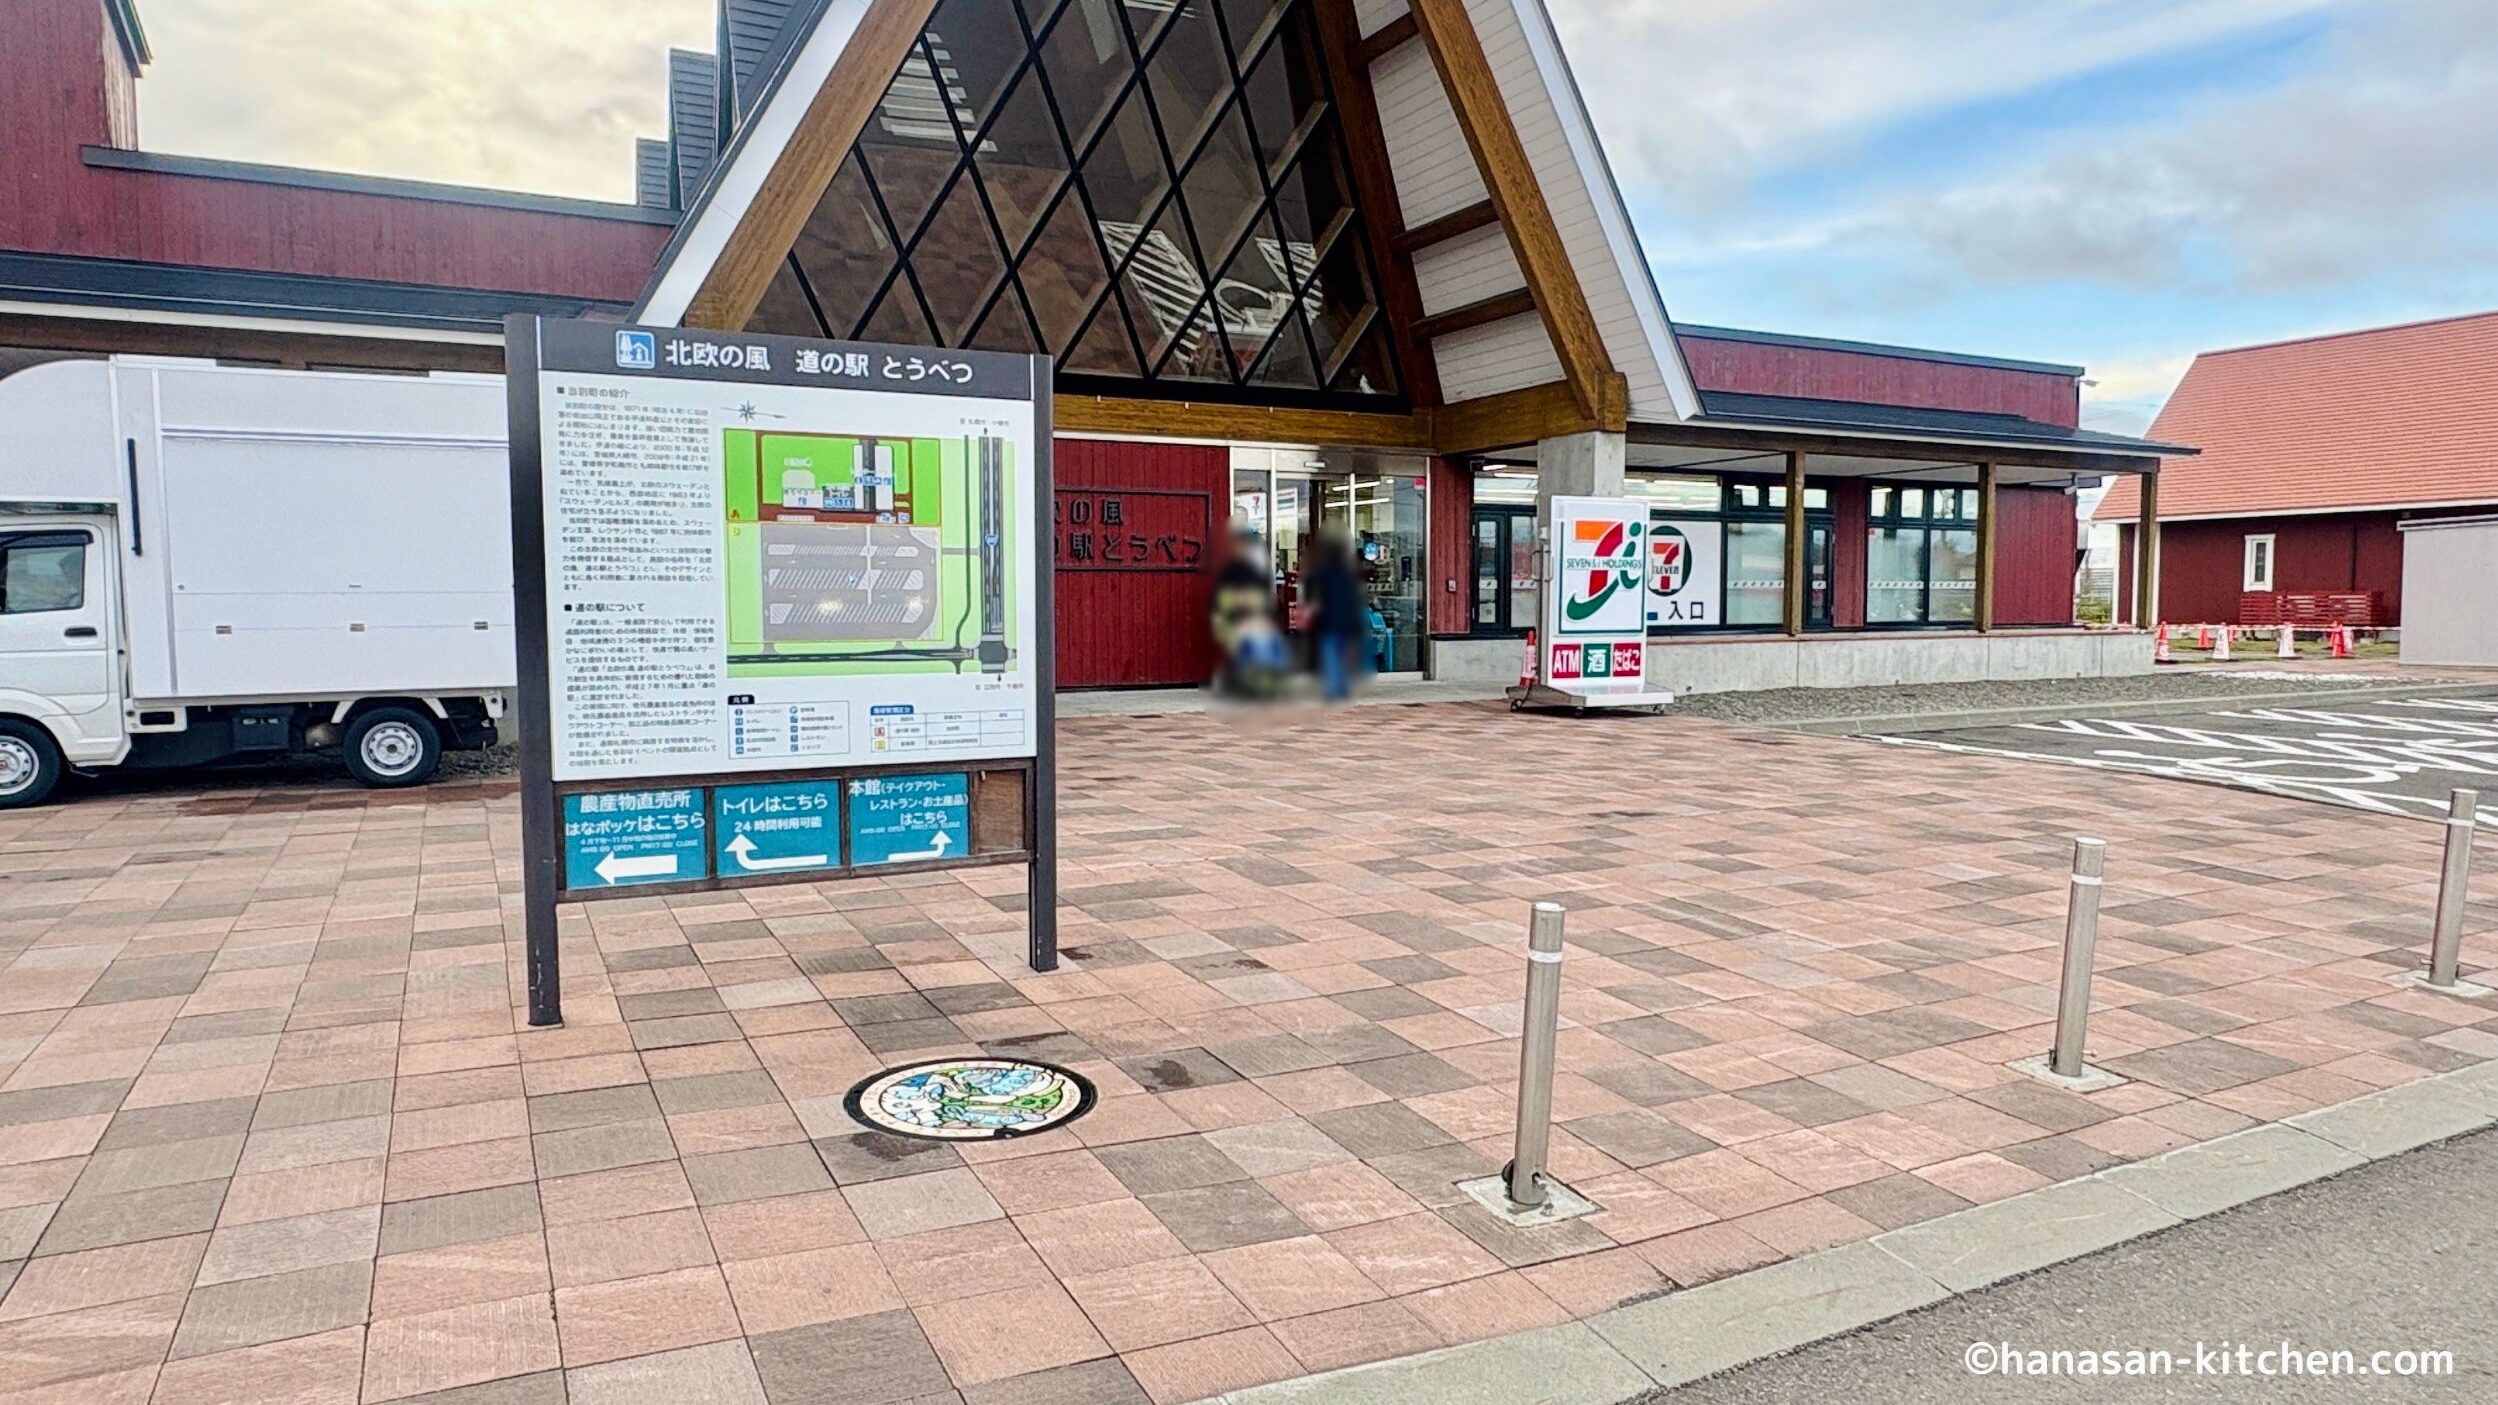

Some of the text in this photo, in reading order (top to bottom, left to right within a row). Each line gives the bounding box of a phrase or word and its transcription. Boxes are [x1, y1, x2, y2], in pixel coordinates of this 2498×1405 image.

[665, 339, 973, 384] 北欧の風 道の駅 とうべつ
[1602, 558, 1642, 569] HOLDINGS
[575, 603, 645, 613] 道の駅について
[1669, 601, 1704, 620] 入口
[1553, 650, 1580, 673] ATM
[1587, 649, 1606, 673] 酒
[1614, 649, 1640, 672] たばこ
[580, 791, 692, 813] 農産物直売所
[723, 794, 829, 816] トイレはこちら
[565, 812, 706, 837] はなポッケはこちら
[734, 816, 823, 833] 24時間利用可能
[901, 810, 947, 826] はこちら
